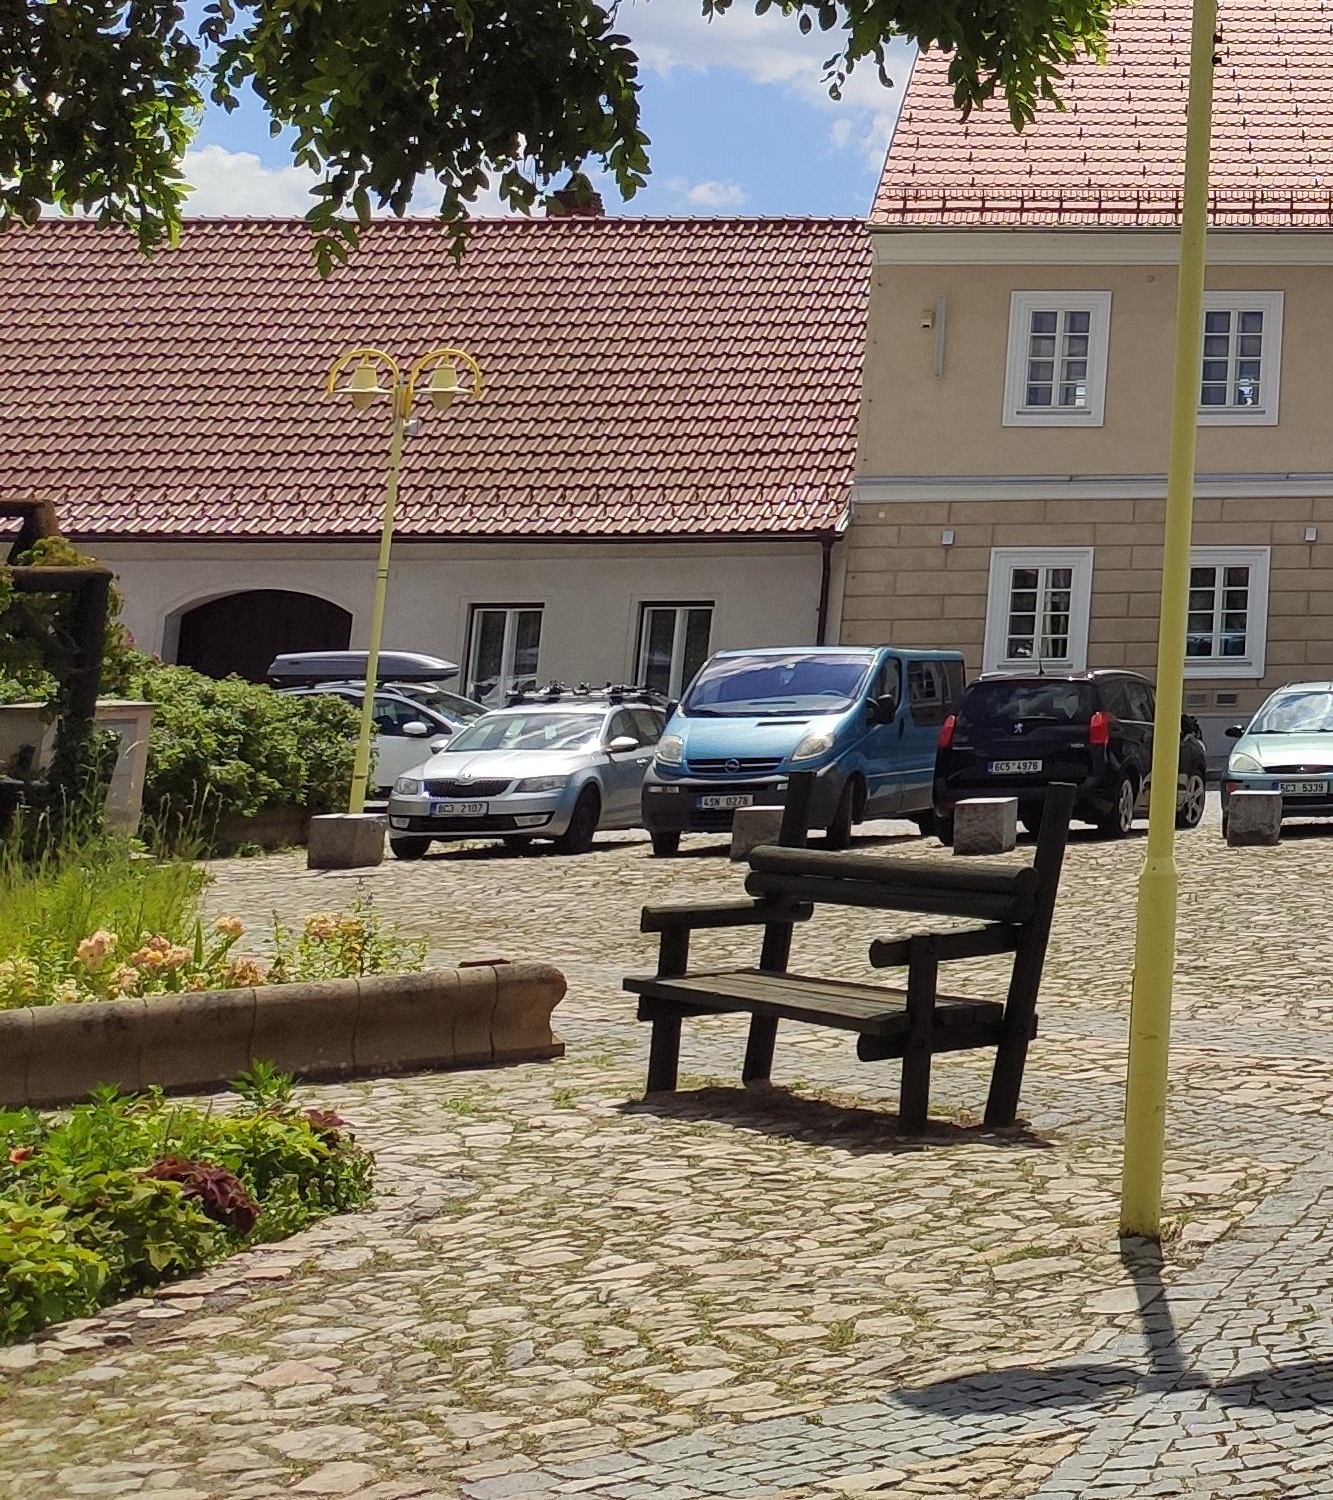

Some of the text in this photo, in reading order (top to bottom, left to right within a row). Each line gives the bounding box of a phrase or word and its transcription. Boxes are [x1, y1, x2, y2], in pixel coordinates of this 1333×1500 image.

[994, 761, 1038, 772] 6C5 4976
[459, 803, 484, 813] 2107
